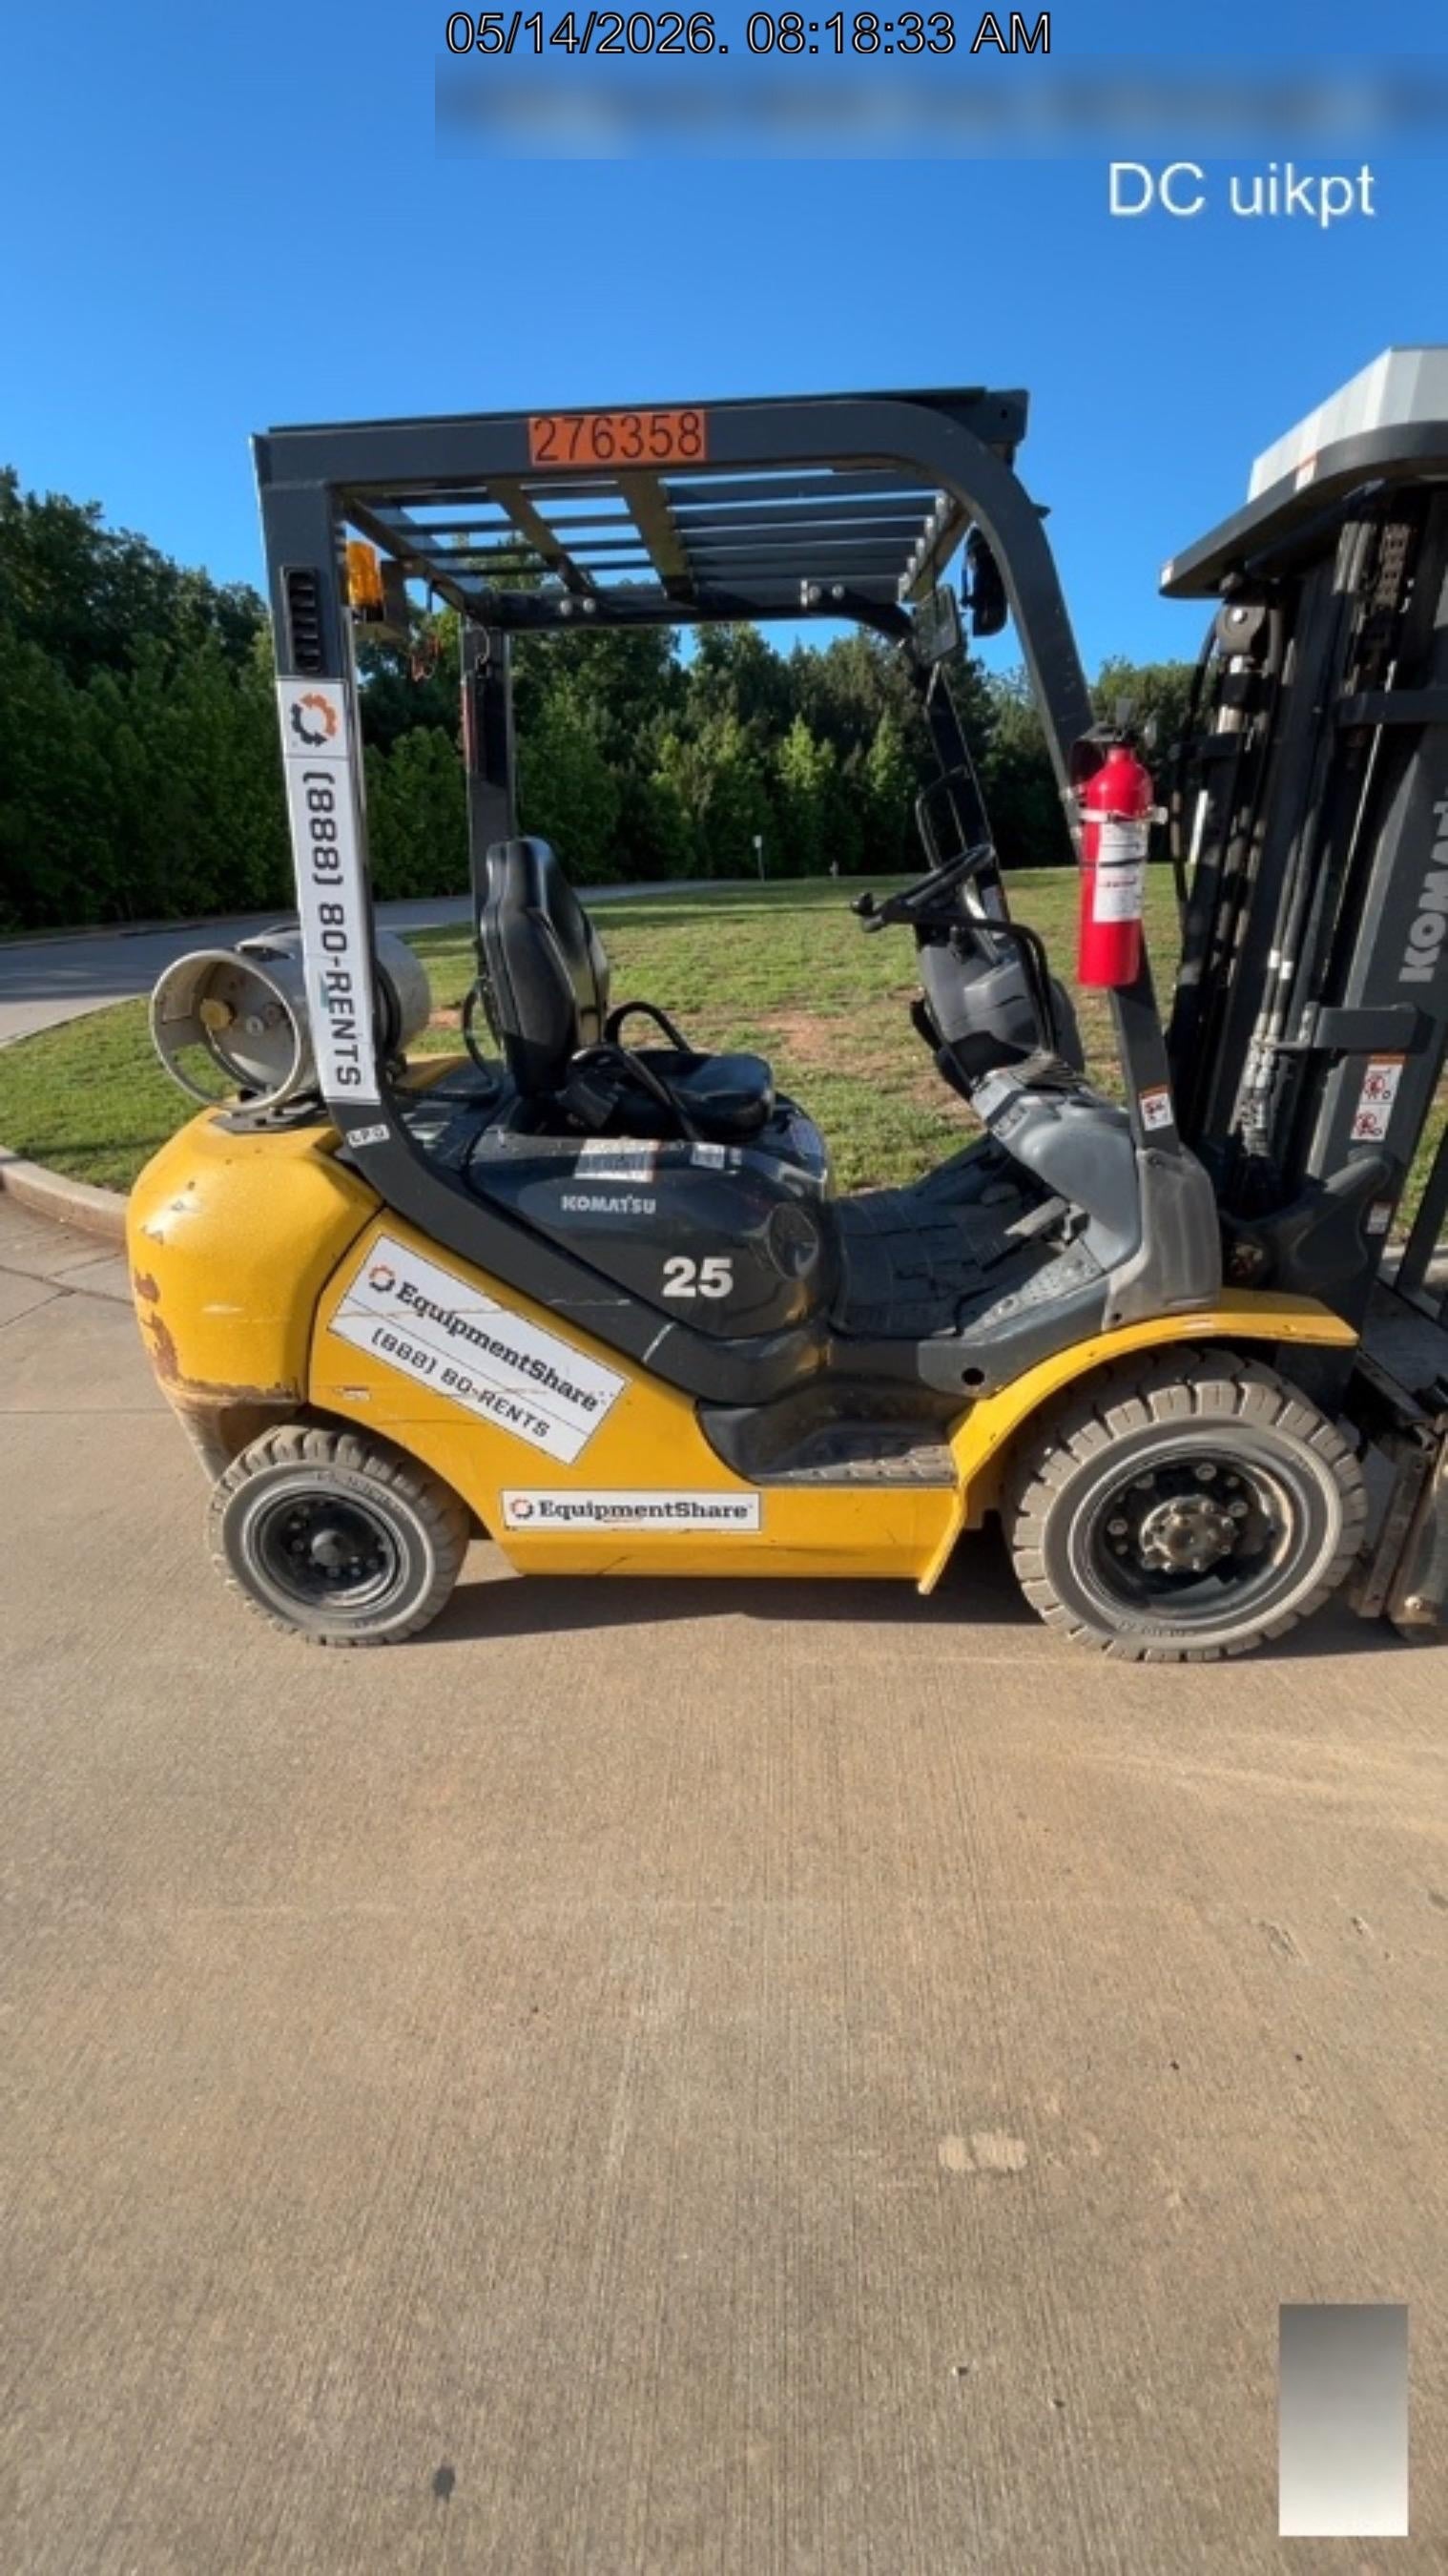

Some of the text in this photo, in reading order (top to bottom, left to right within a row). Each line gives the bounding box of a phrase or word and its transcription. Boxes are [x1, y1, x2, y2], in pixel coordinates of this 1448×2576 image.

[533, 411, 702, 462] 276358
[302, 770, 362, 1088] (888) 80-RENTS
[561, 1195, 657, 1215] KOMATSU
[660, 1256, 734, 1298] 25
[394, 1280, 598, 1413] EquipmentShare
[370, 1326, 551, 1440] (888) 80-RENTS
[538, 1499, 748, 1522] EquipmentShare
